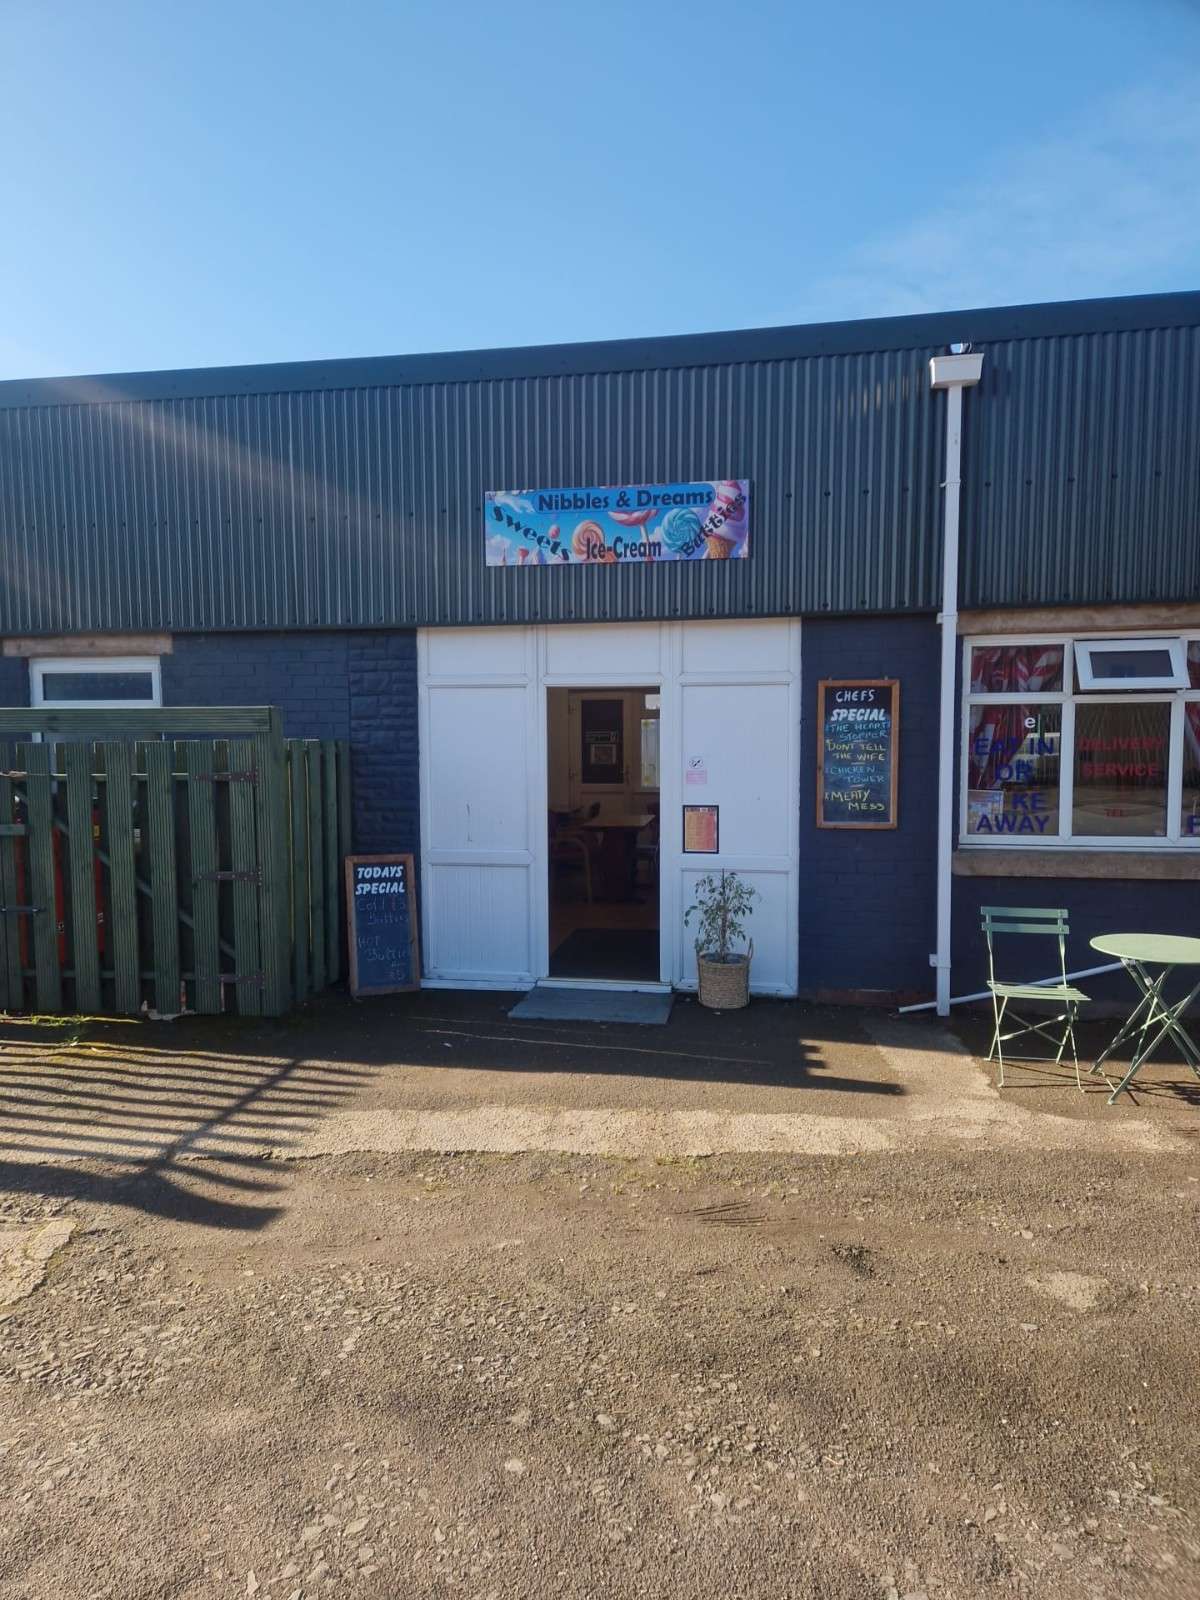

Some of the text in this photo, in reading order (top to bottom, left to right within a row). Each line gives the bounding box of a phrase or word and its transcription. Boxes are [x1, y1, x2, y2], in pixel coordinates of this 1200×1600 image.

[538, 488, 712, 511] Nibbles & Dreams
[493, 505, 571, 561] Sweets
[586, 536, 662, 559] Ice-Cream
[831, 708, 886, 722] SPECIAL
[831, 723, 849, 732] THE
[1029, 737, 1054, 755] IN
[856, 752, 885, 761] WIFE
[1083, 762, 1160, 778] SERVICE
[976, 814, 1050, 833] AWAY
[357, 866, 404, 879] TODAYS
[355, 882, 406, 895] SPECIAL
